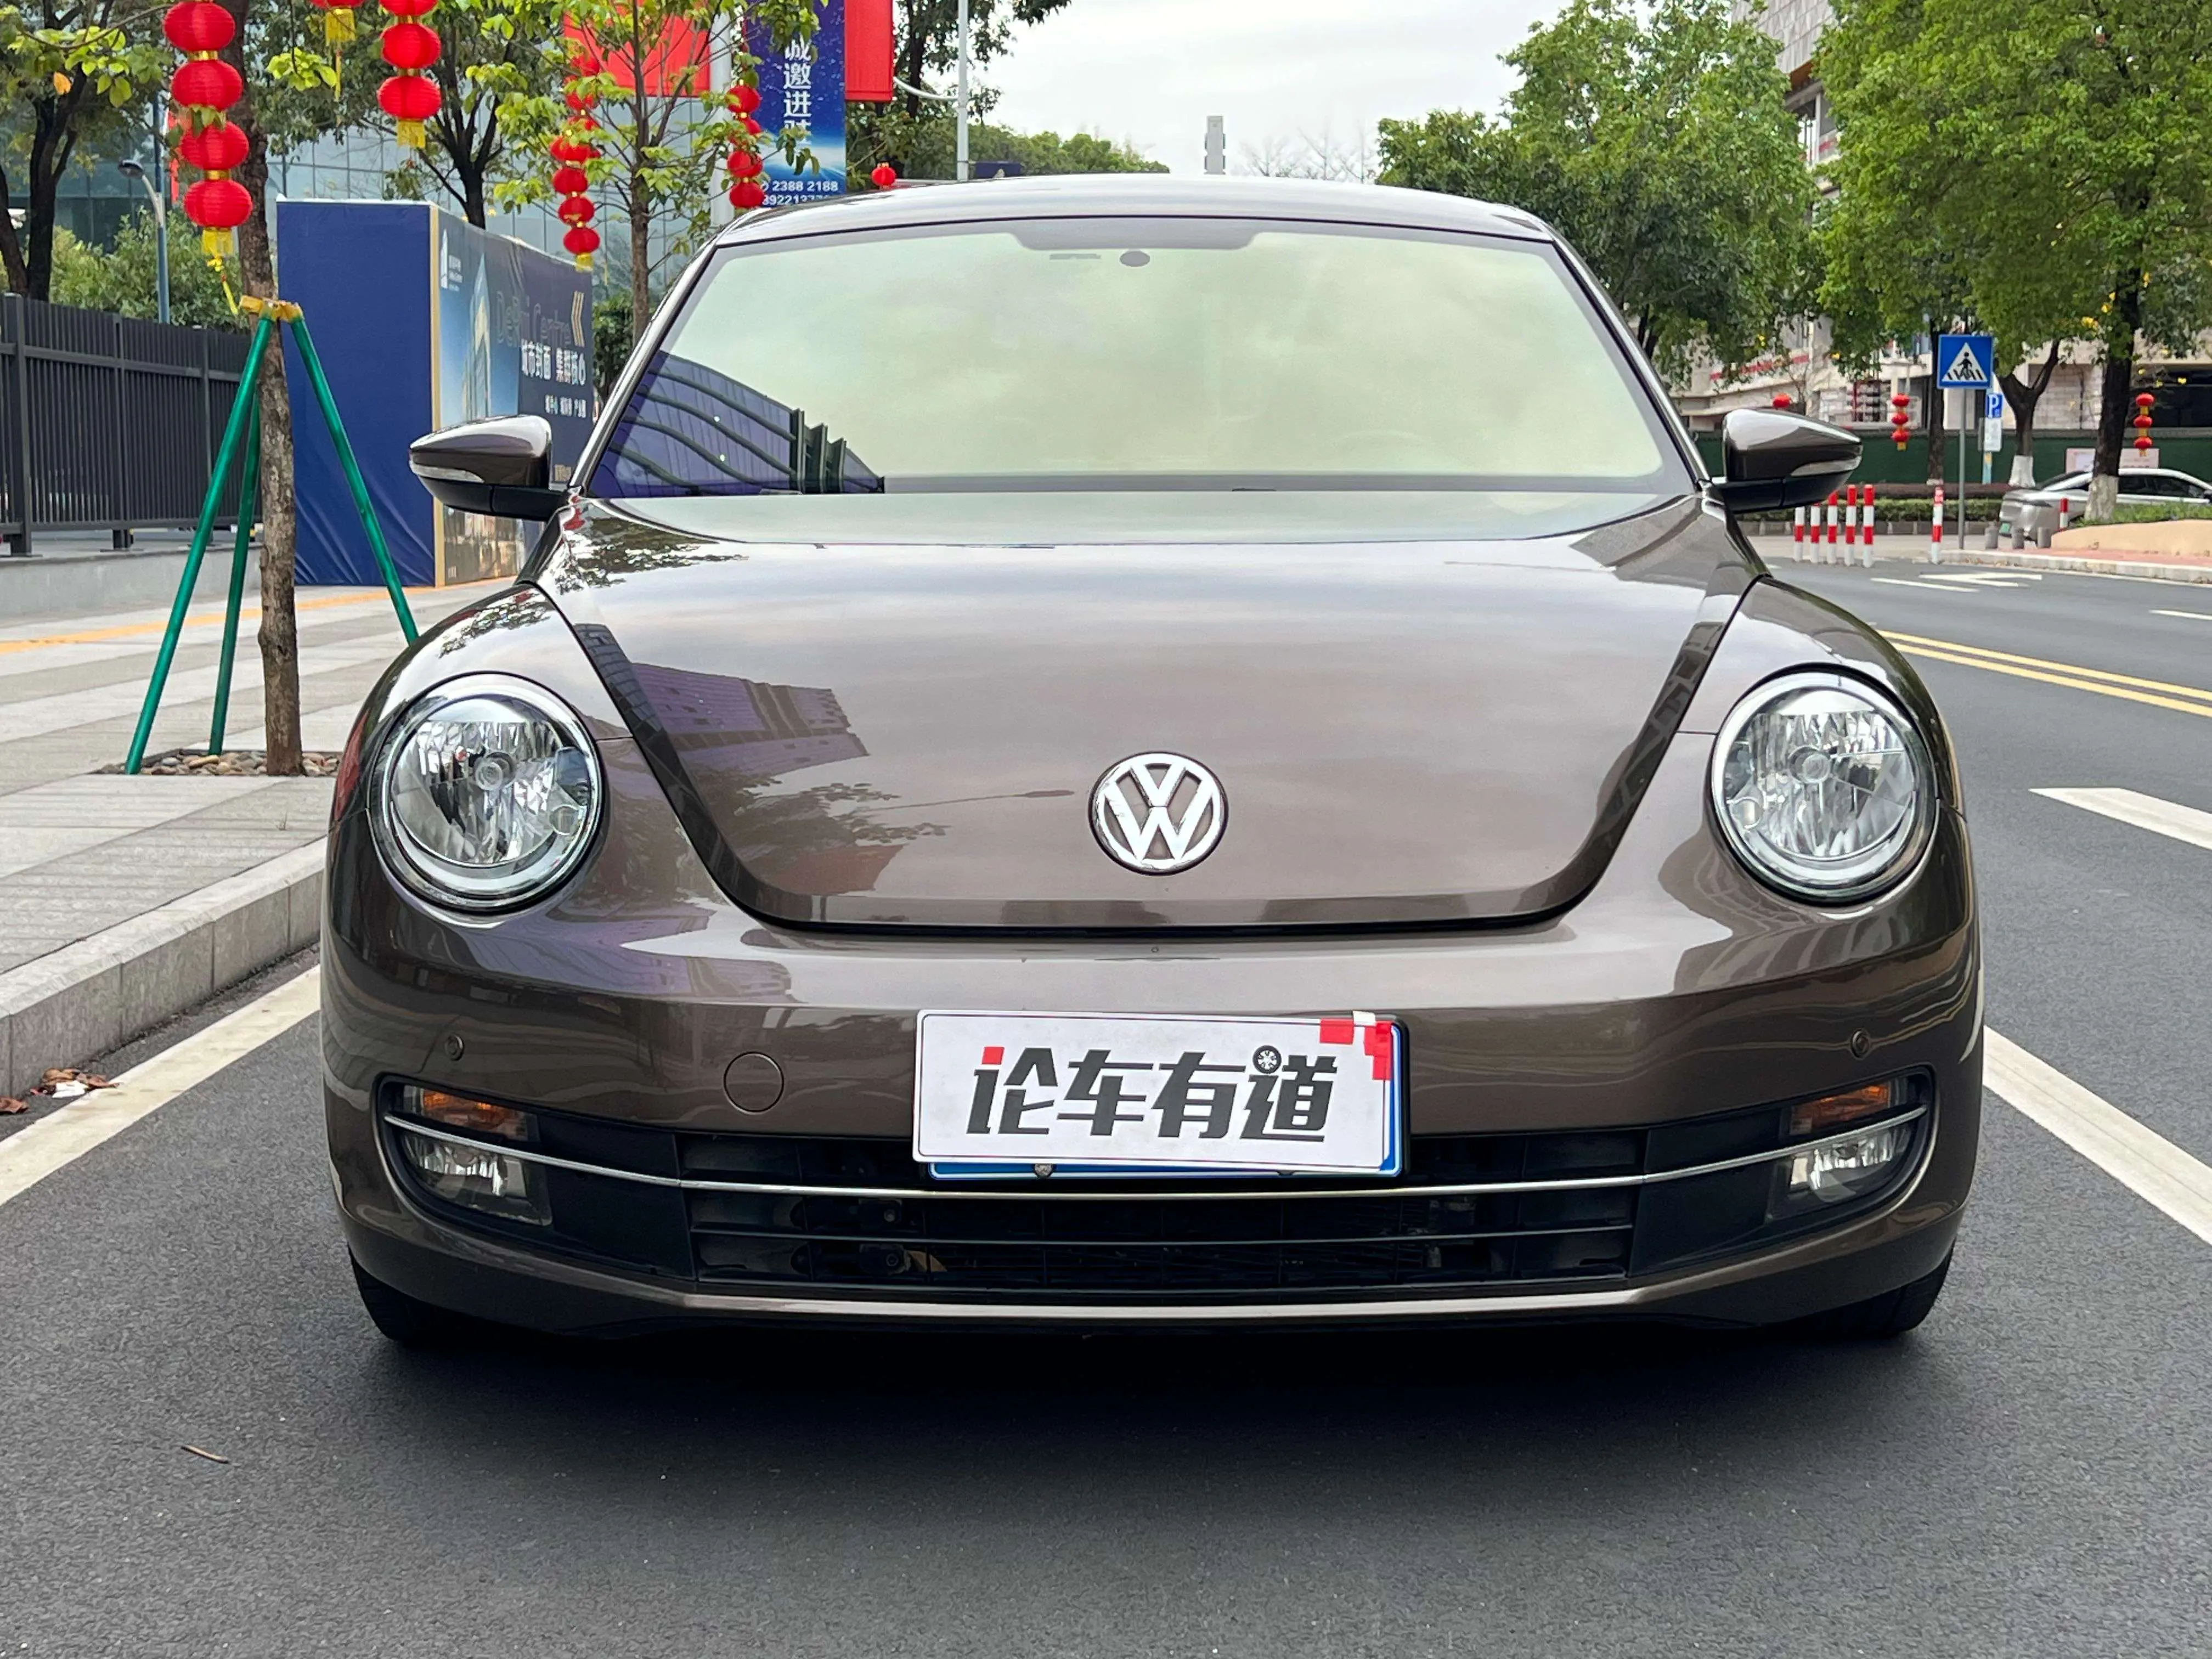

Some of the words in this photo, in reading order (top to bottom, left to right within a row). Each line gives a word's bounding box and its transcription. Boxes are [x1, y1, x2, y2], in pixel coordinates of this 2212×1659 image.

[772, 180, 803, 191] 2388
[807, 181, 838, 191] 2188
[1988, 394, 1999, 418] P
[966, 1045, 1338, 1143] 论车有道
